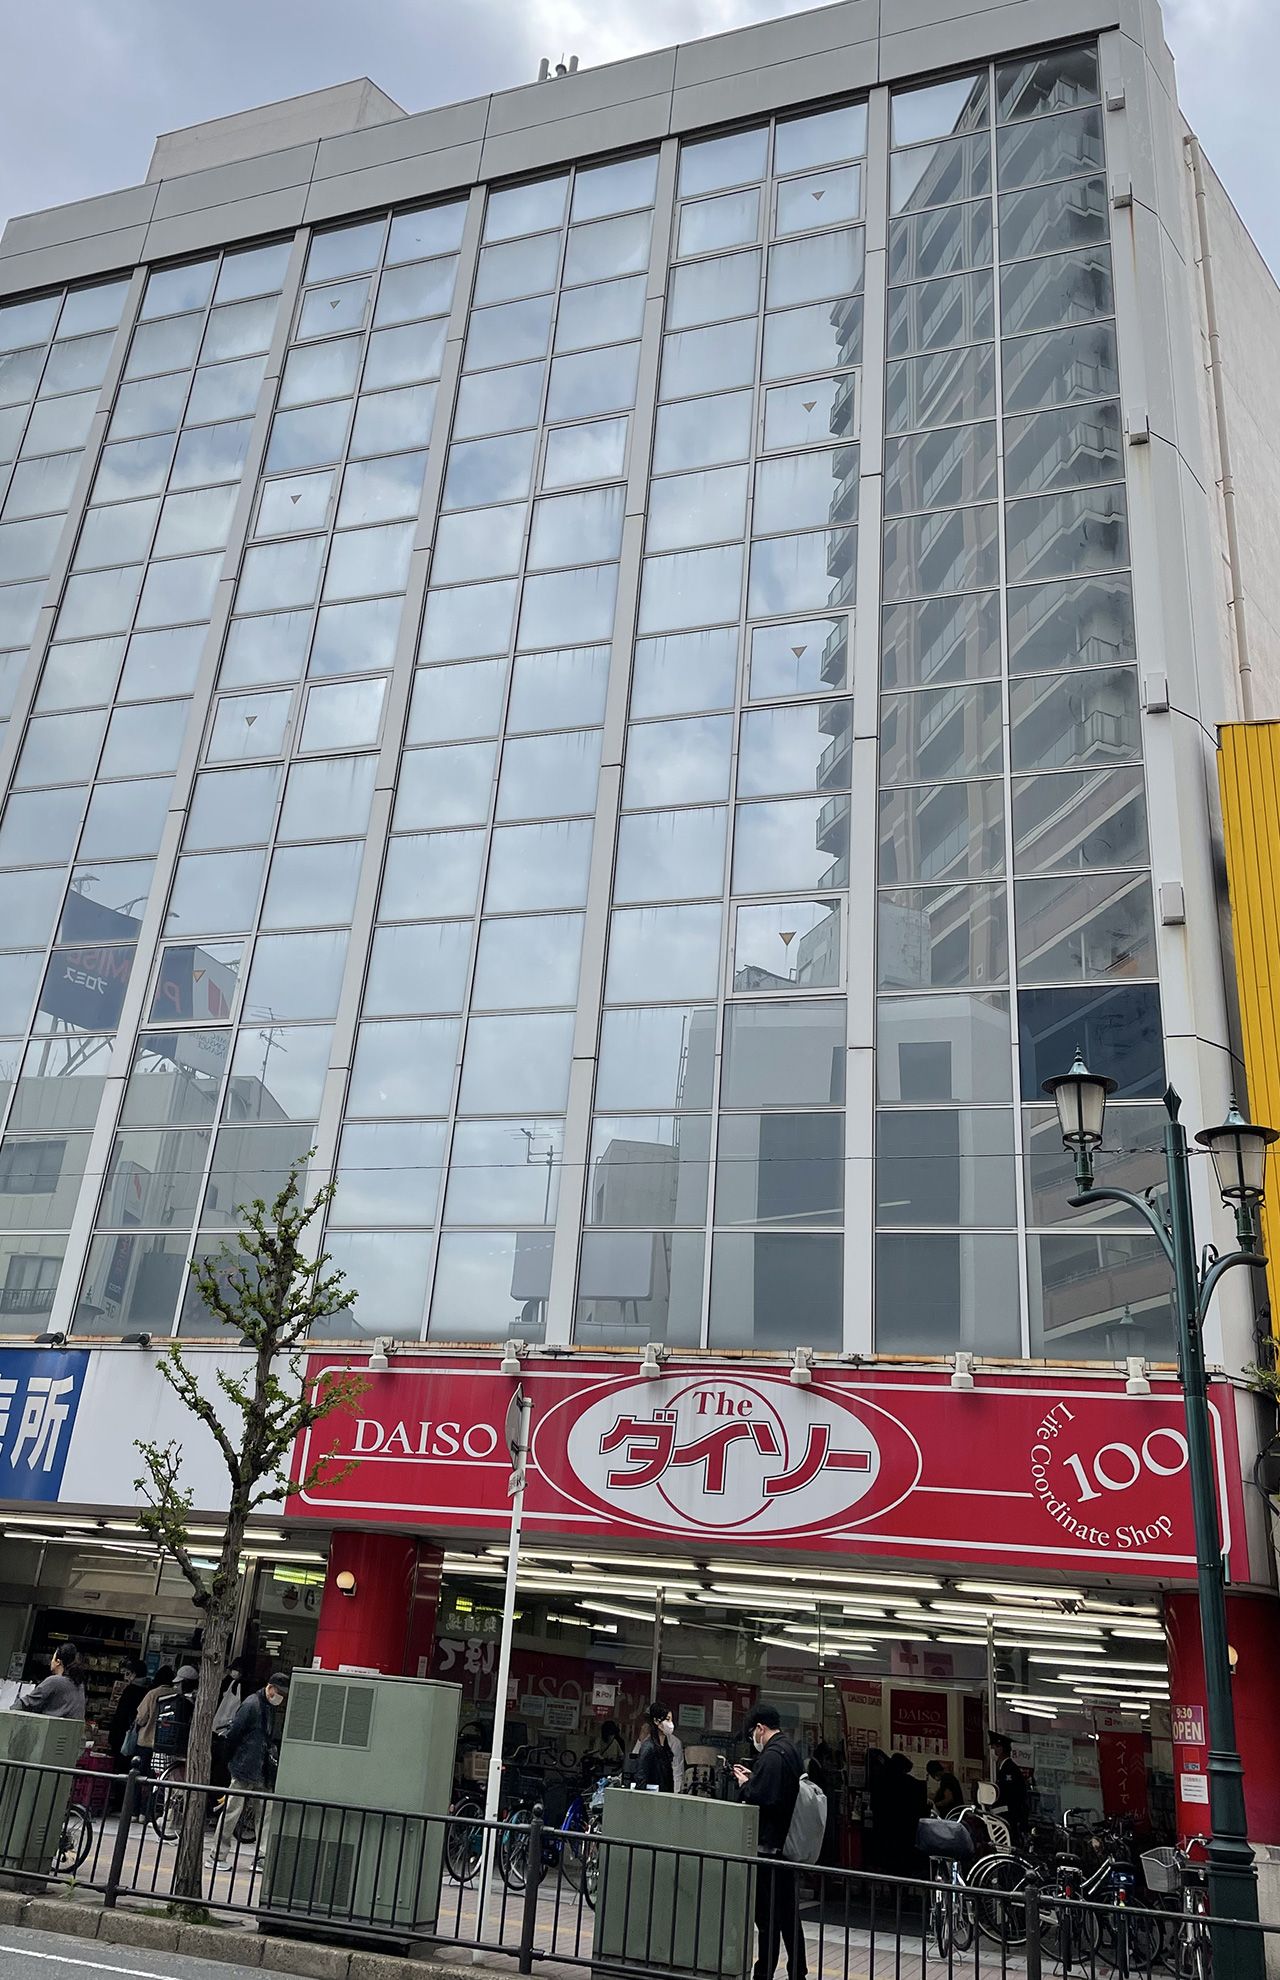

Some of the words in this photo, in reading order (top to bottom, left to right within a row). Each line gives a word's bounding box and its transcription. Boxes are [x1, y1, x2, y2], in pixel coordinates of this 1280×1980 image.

[692, 1390, 753, 1417] The
[1034, 1400, 1077, 1442] Life
[351, 1419, 499, 1459] DAISO
[599, 1408, 872, 1498] ダイソー
[1062, 1426, 1190, 1504] 100
[1028, 1443, 1111, 1548] Coordinate
[1115, 1511, 1174, 1549] Shop
[898, 1708, 941, 1722] DAISO
[1173, 1721, 1202, 1741] OPEN
[1176, 1707, 1193, 1719] 9:30
[1018, 1750, 1032, 1761] Pay
